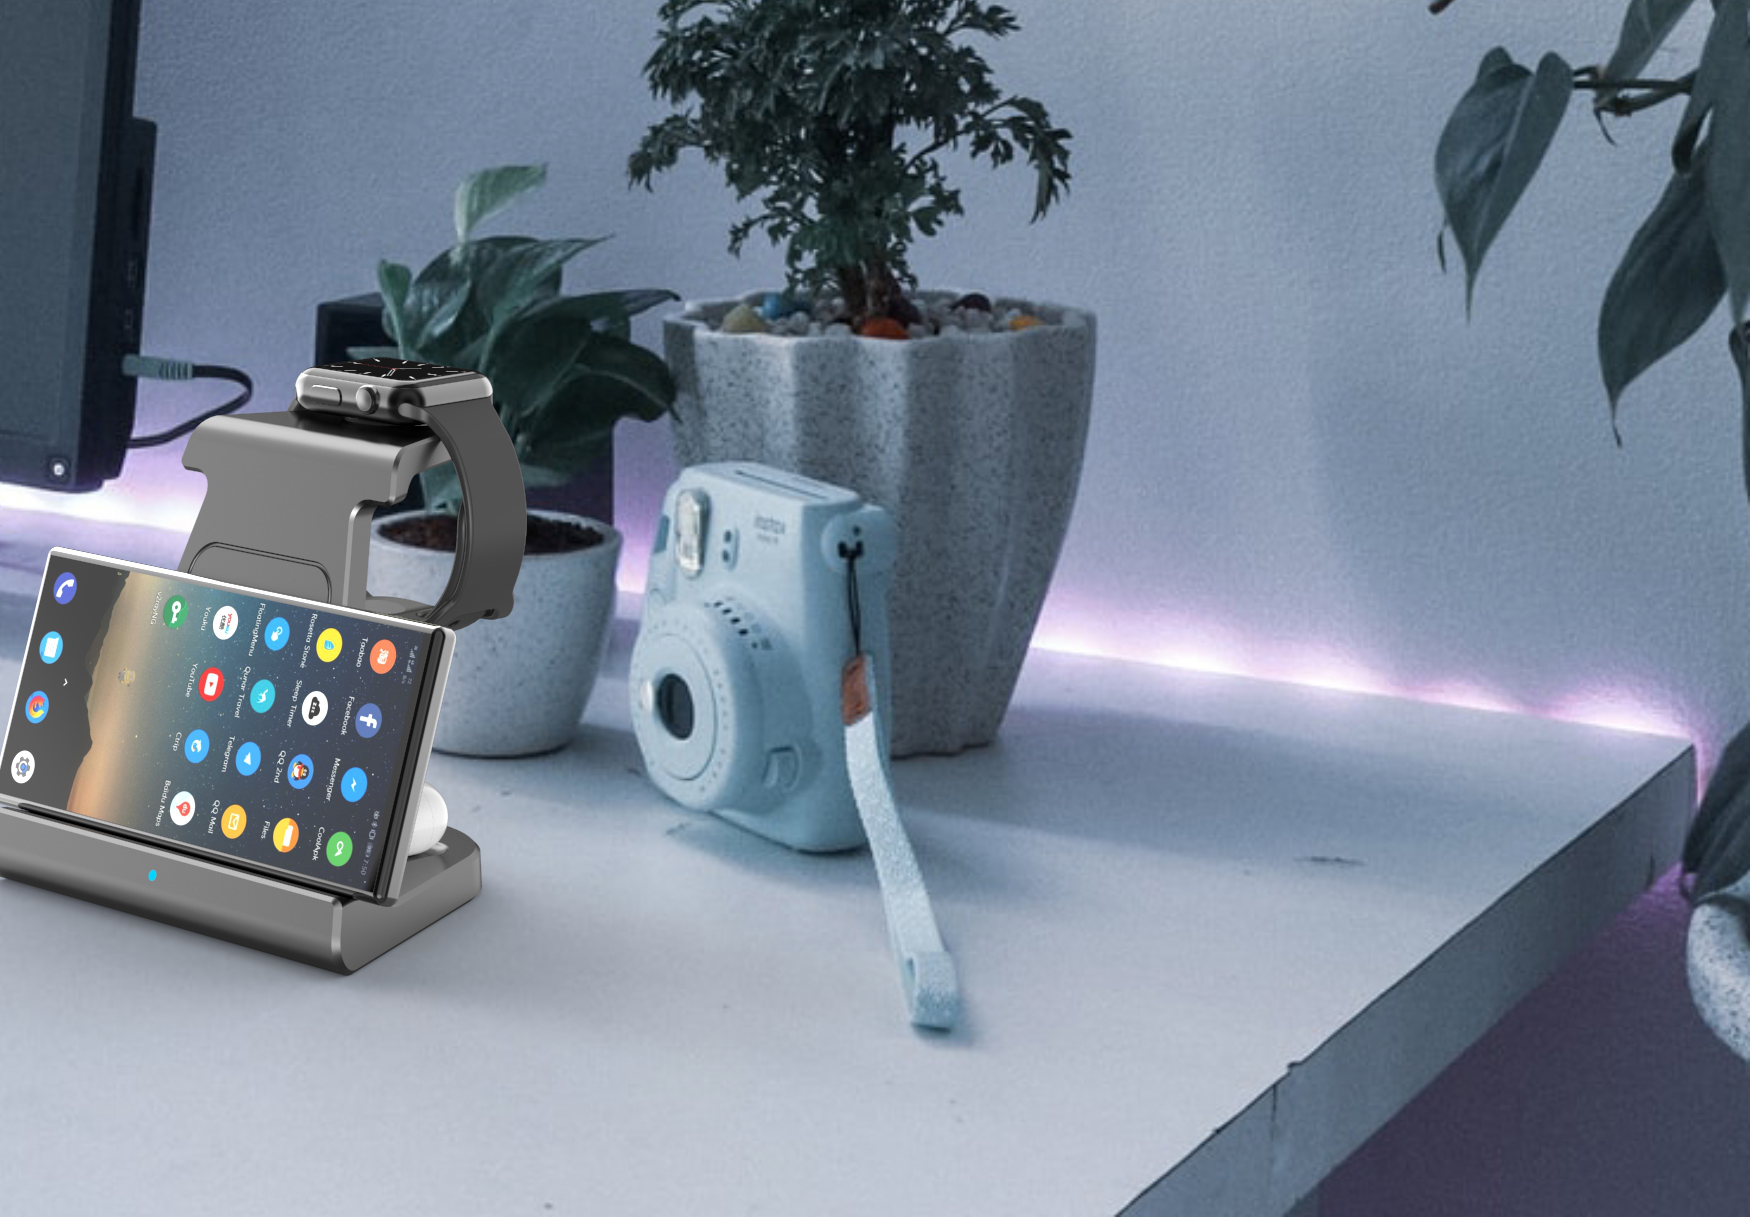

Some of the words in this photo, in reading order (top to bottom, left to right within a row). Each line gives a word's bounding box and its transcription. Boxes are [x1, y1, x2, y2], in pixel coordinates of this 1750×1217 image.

[150, 591, 163, 624] v2rayNG
[201, 606, 211, 630] Youku
[249, 603, 266, 656] FloatingMenu
[306, 613, 318, 642] Rosetta
[300, 645, 310, 668] Stone
[357, 637, 368, 667] Taobao
[186, 662, 198, 697] YouTube
[241, 666, 251, 691] Qunar
[292, 680, 303, 701] Sleep
[235, 693, 245, 718] Travel
[287, 704, 297, 727] Timer
[341, 696, 355, 735] Facebook
[173, 731, 182, 751] Ctrip
[222, 735, 235, 772] Telegram
[277, 750, 286, 764] QQ
[274, 767, 282, 783] 2nd
[326, 758, 341, 800] Messenger
[161, 780, 172, 802] Baidu
[155, 805, 165, 826] Maps
[212, 799, 221, 814] QQ
[208, 816, 217, 833] Mail
[261, 820, 271, 838] Files
[312, 826, 325, 860] CoolApk
[360, 859, 369, 876] 7:50
